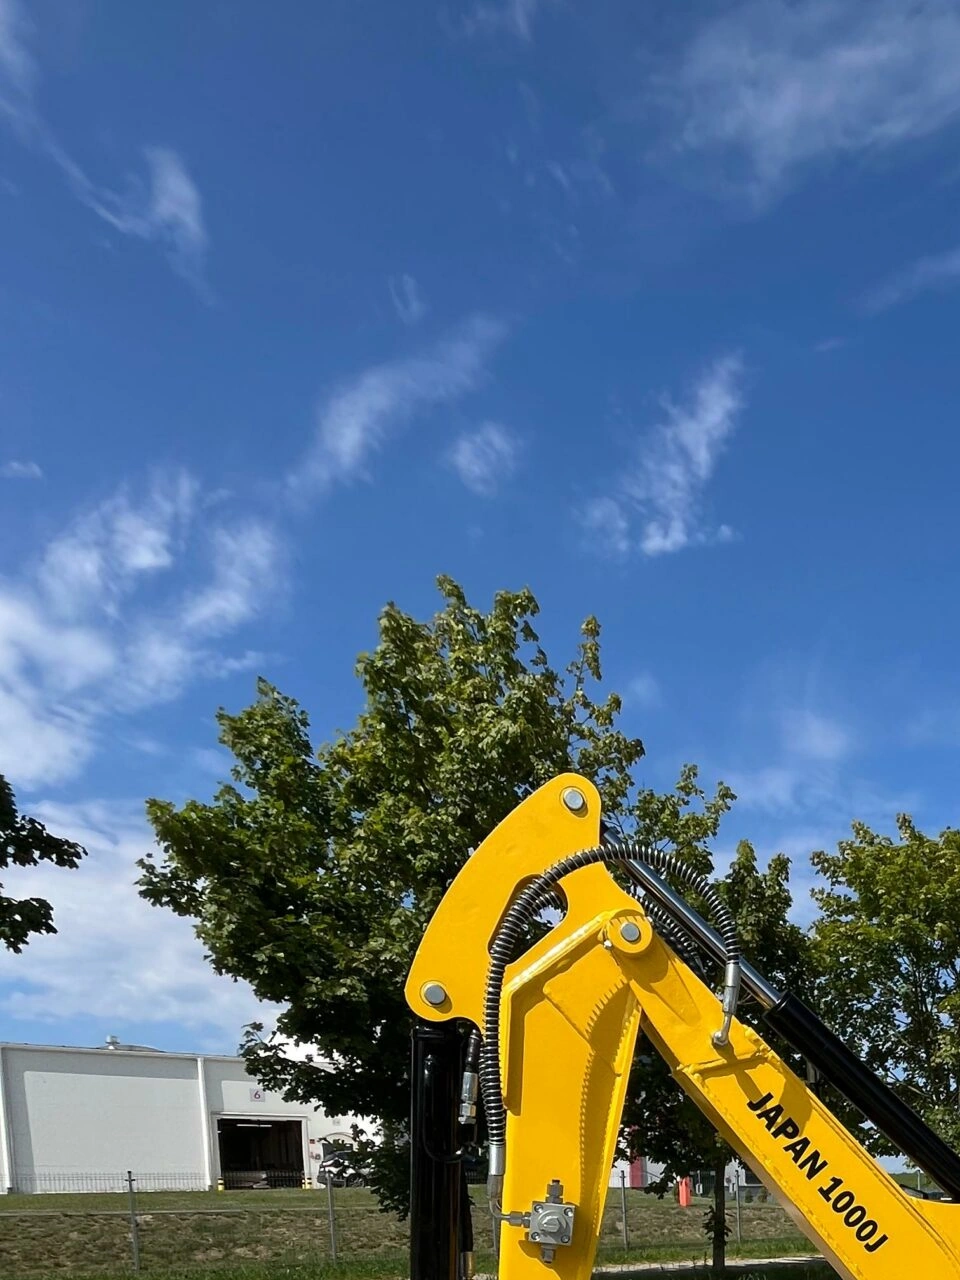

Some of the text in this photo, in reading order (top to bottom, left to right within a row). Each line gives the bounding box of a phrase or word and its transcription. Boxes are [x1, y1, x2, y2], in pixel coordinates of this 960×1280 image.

[254, 1090, 261, 1100] 6
[746, 1092, 889, 1253] JAPAN 1000J
